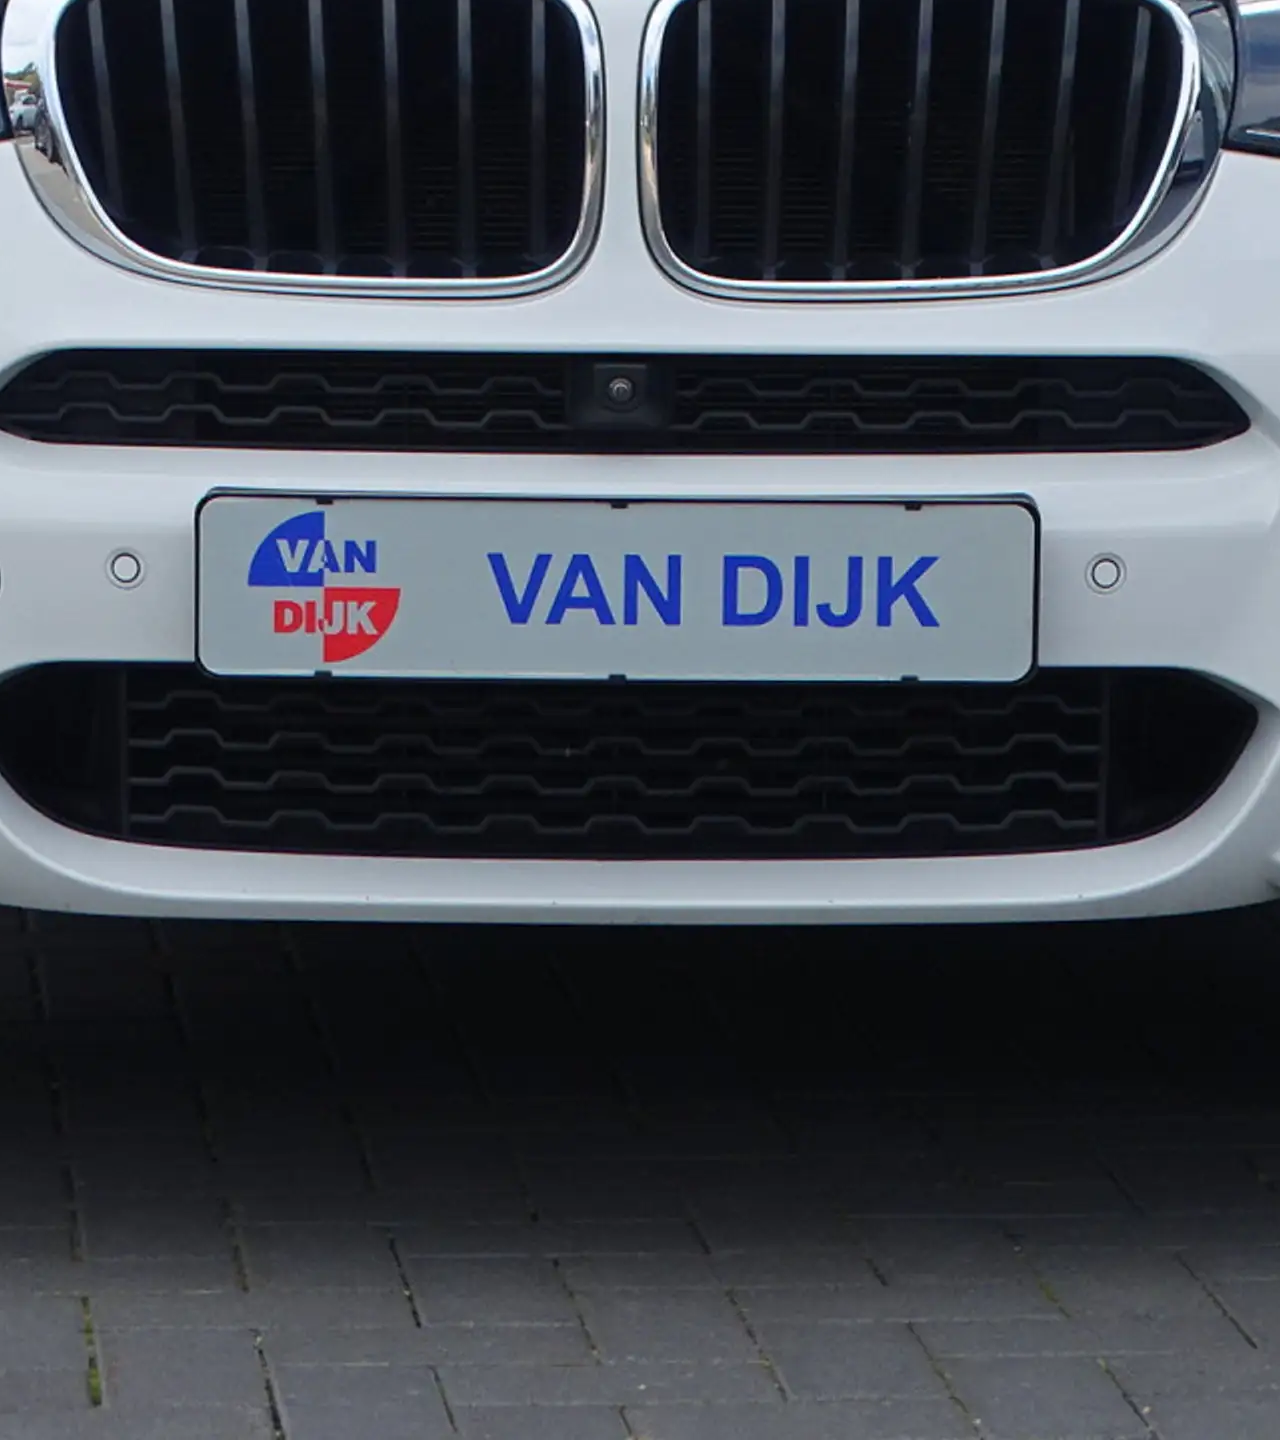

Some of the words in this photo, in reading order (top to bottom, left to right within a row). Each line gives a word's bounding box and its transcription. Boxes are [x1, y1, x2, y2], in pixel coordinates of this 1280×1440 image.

[276, 539, 377, 574] VAN
[486, 553, 682, 626] VAN
[722, 555, 940, 628] DIJK
[274, 600, 378, 635] DIJK
